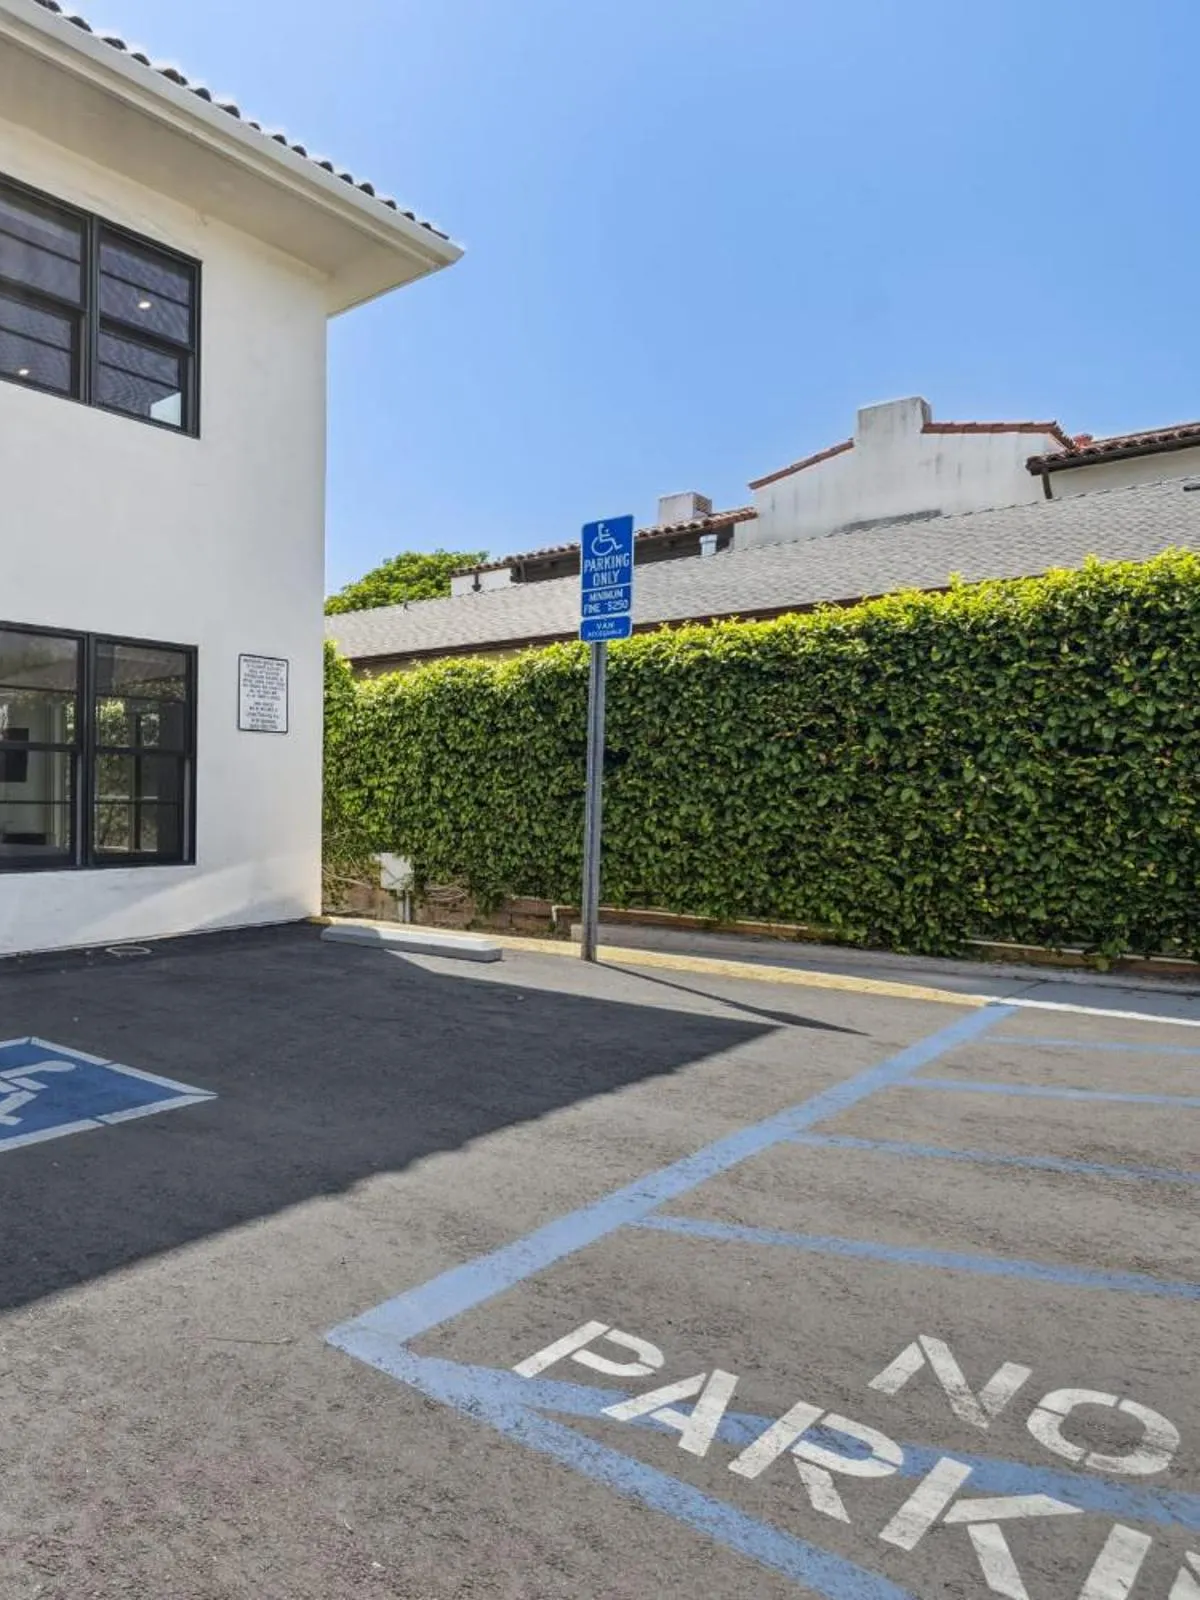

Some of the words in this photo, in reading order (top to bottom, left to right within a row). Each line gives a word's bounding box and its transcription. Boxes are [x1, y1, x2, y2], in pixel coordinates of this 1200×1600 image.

[584, 553, 630, 574] PARKING
[593, 570, 620, 587] ONLY
[867, 1334, 1181, 1475] NO
[512, 1320, 1200, 1600] PARKI
